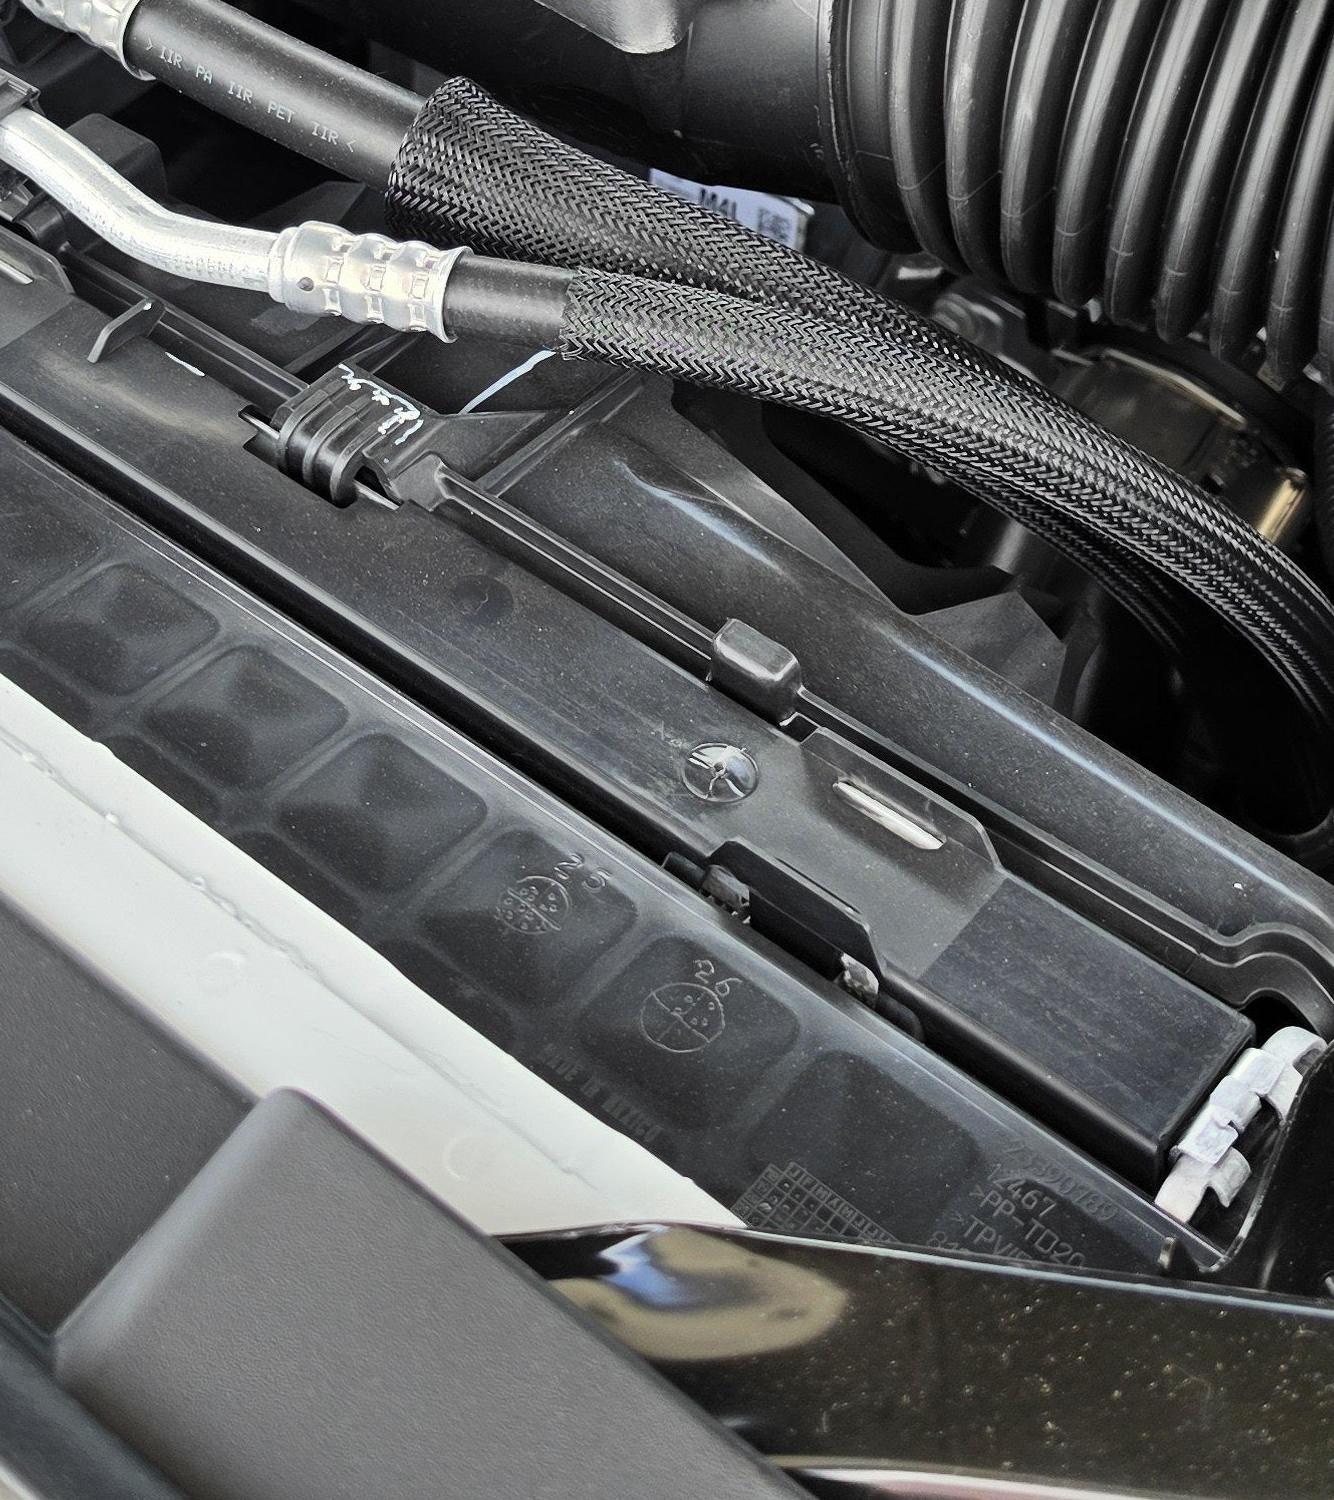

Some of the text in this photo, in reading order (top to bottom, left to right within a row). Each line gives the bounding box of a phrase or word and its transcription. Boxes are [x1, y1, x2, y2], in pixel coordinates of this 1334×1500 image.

[159, 45, 184, 69] IIR
[194, 63, 214, 85] PA
[227, 80, 254, 104] IIR
[267, 99, 296, 123] PET
[311, 121, 340, 146] IIR
